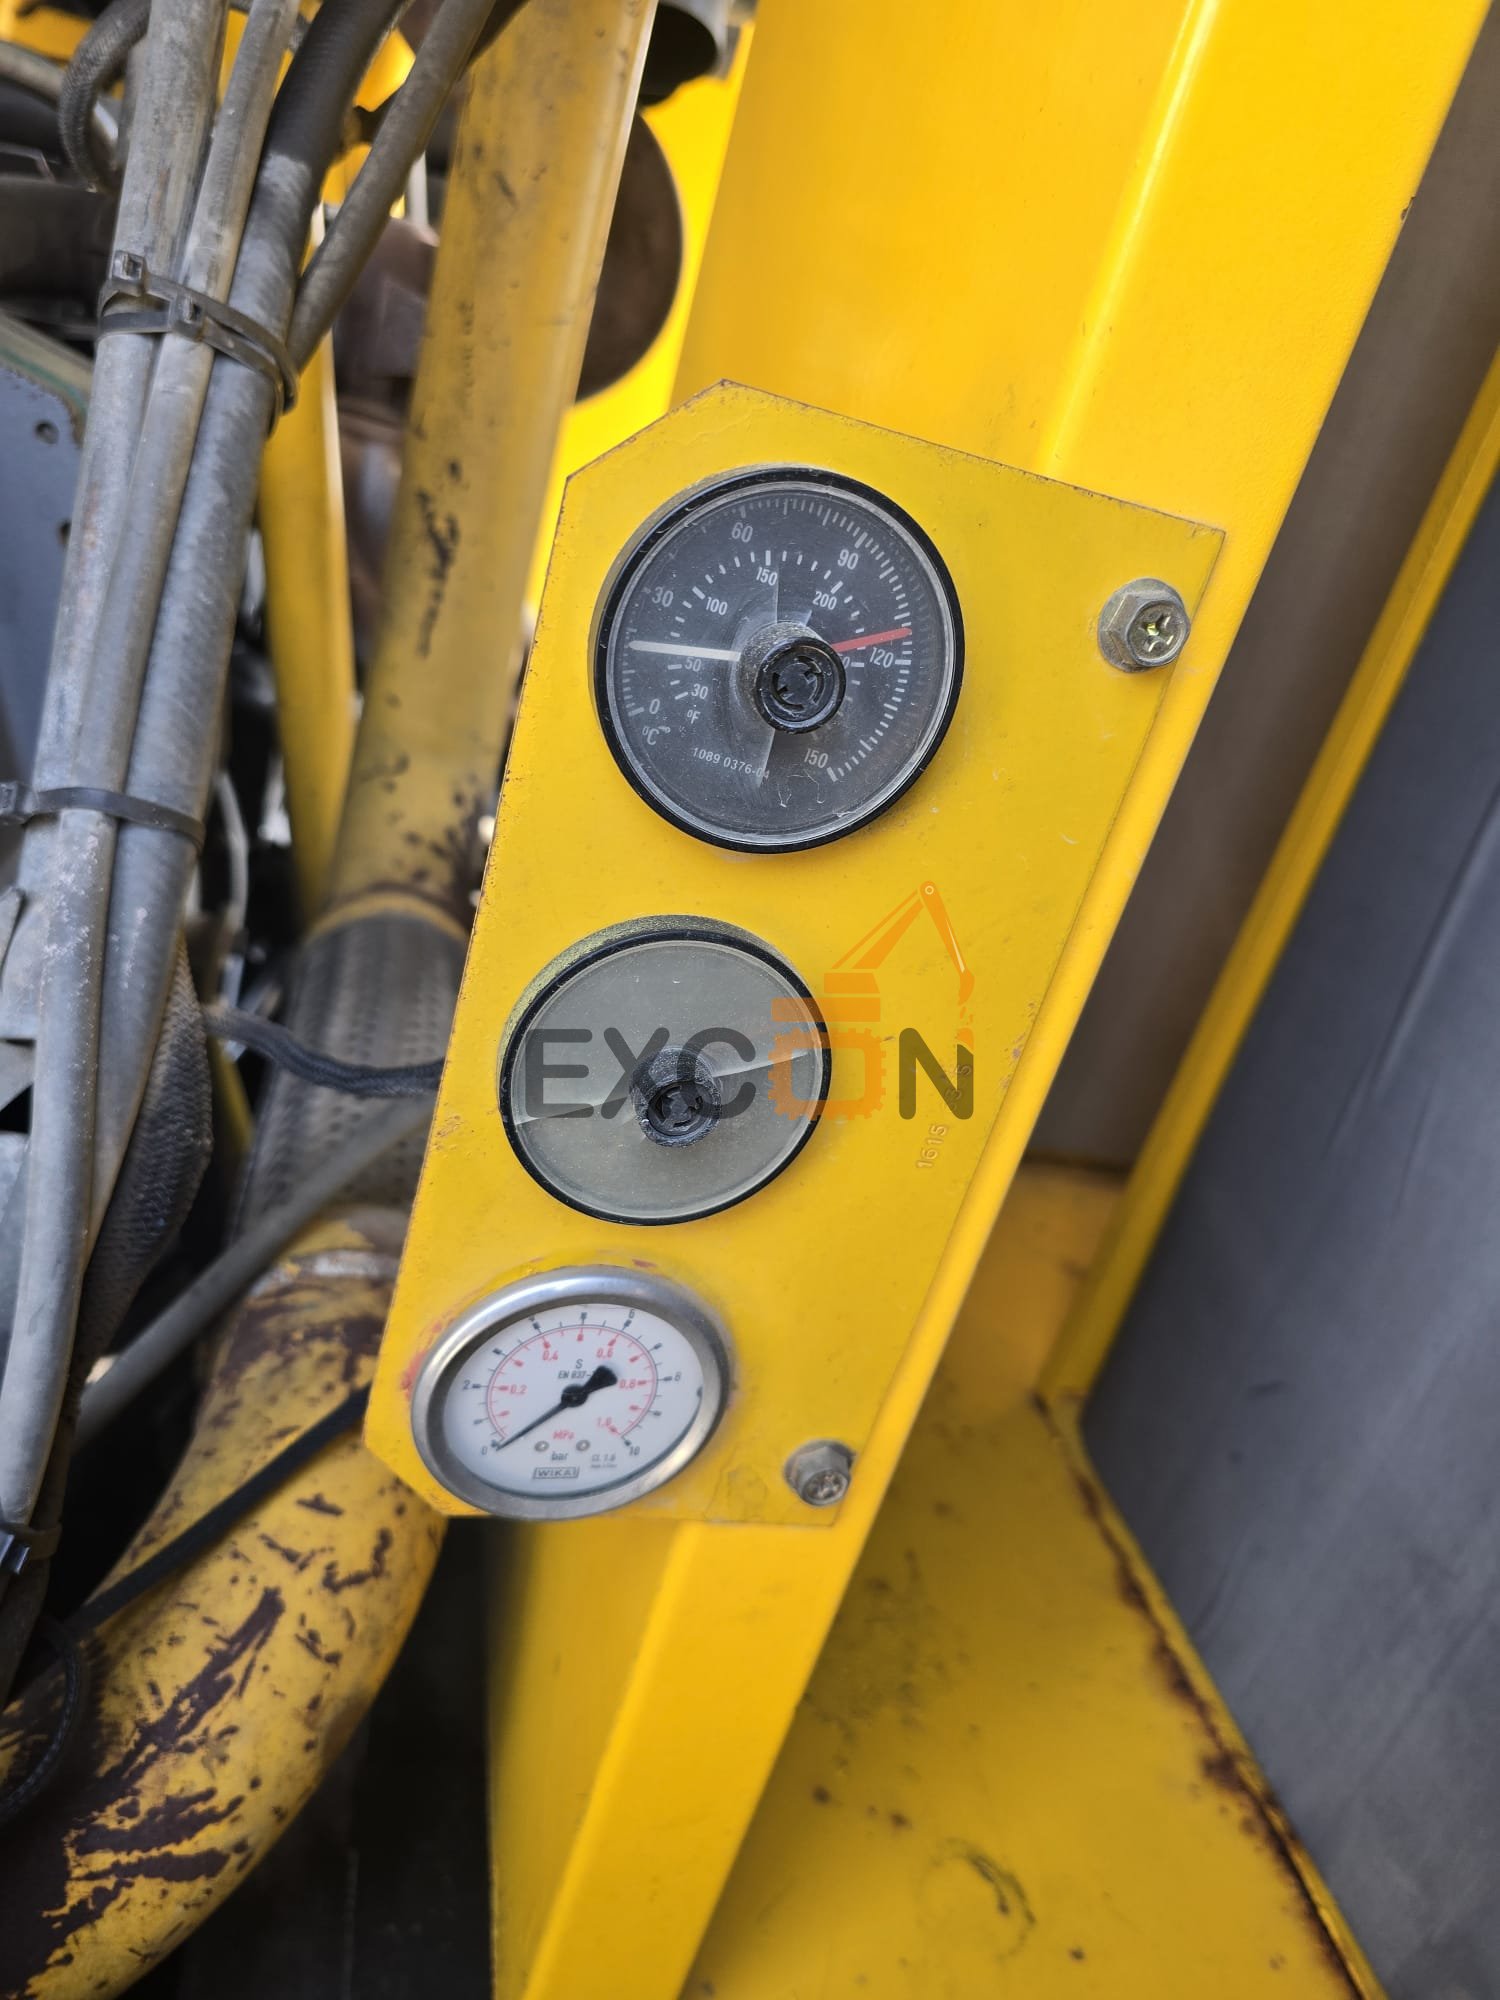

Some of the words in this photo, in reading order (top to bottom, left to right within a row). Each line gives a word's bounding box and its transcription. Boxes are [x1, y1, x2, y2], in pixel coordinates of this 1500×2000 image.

[731, 521, 753, 543] 60
[837, 548, 859, 570] 90
[756, 566, 778, 586] 150
[652, 586, 674, 607] 30
[705, 596, 728, 616] 100
[812, 590, 838, 610] 200
[684, 656, 702, 672] 50
[869, 647, 894, 669] 120
[691, 683, 709, 700] 30
[649, 698, 661, 715] 0
[692, 747, 721, 764] 1089
[804, 748, 829, 769] 150
[915, 1123, 949, 1169] 1615
[575, 1358, 584, 1370] S
[462, 1379, 471, 1391] 2
[481, 1446, 488, 1456] 0
[551, 1451, 569, 1461] bar
